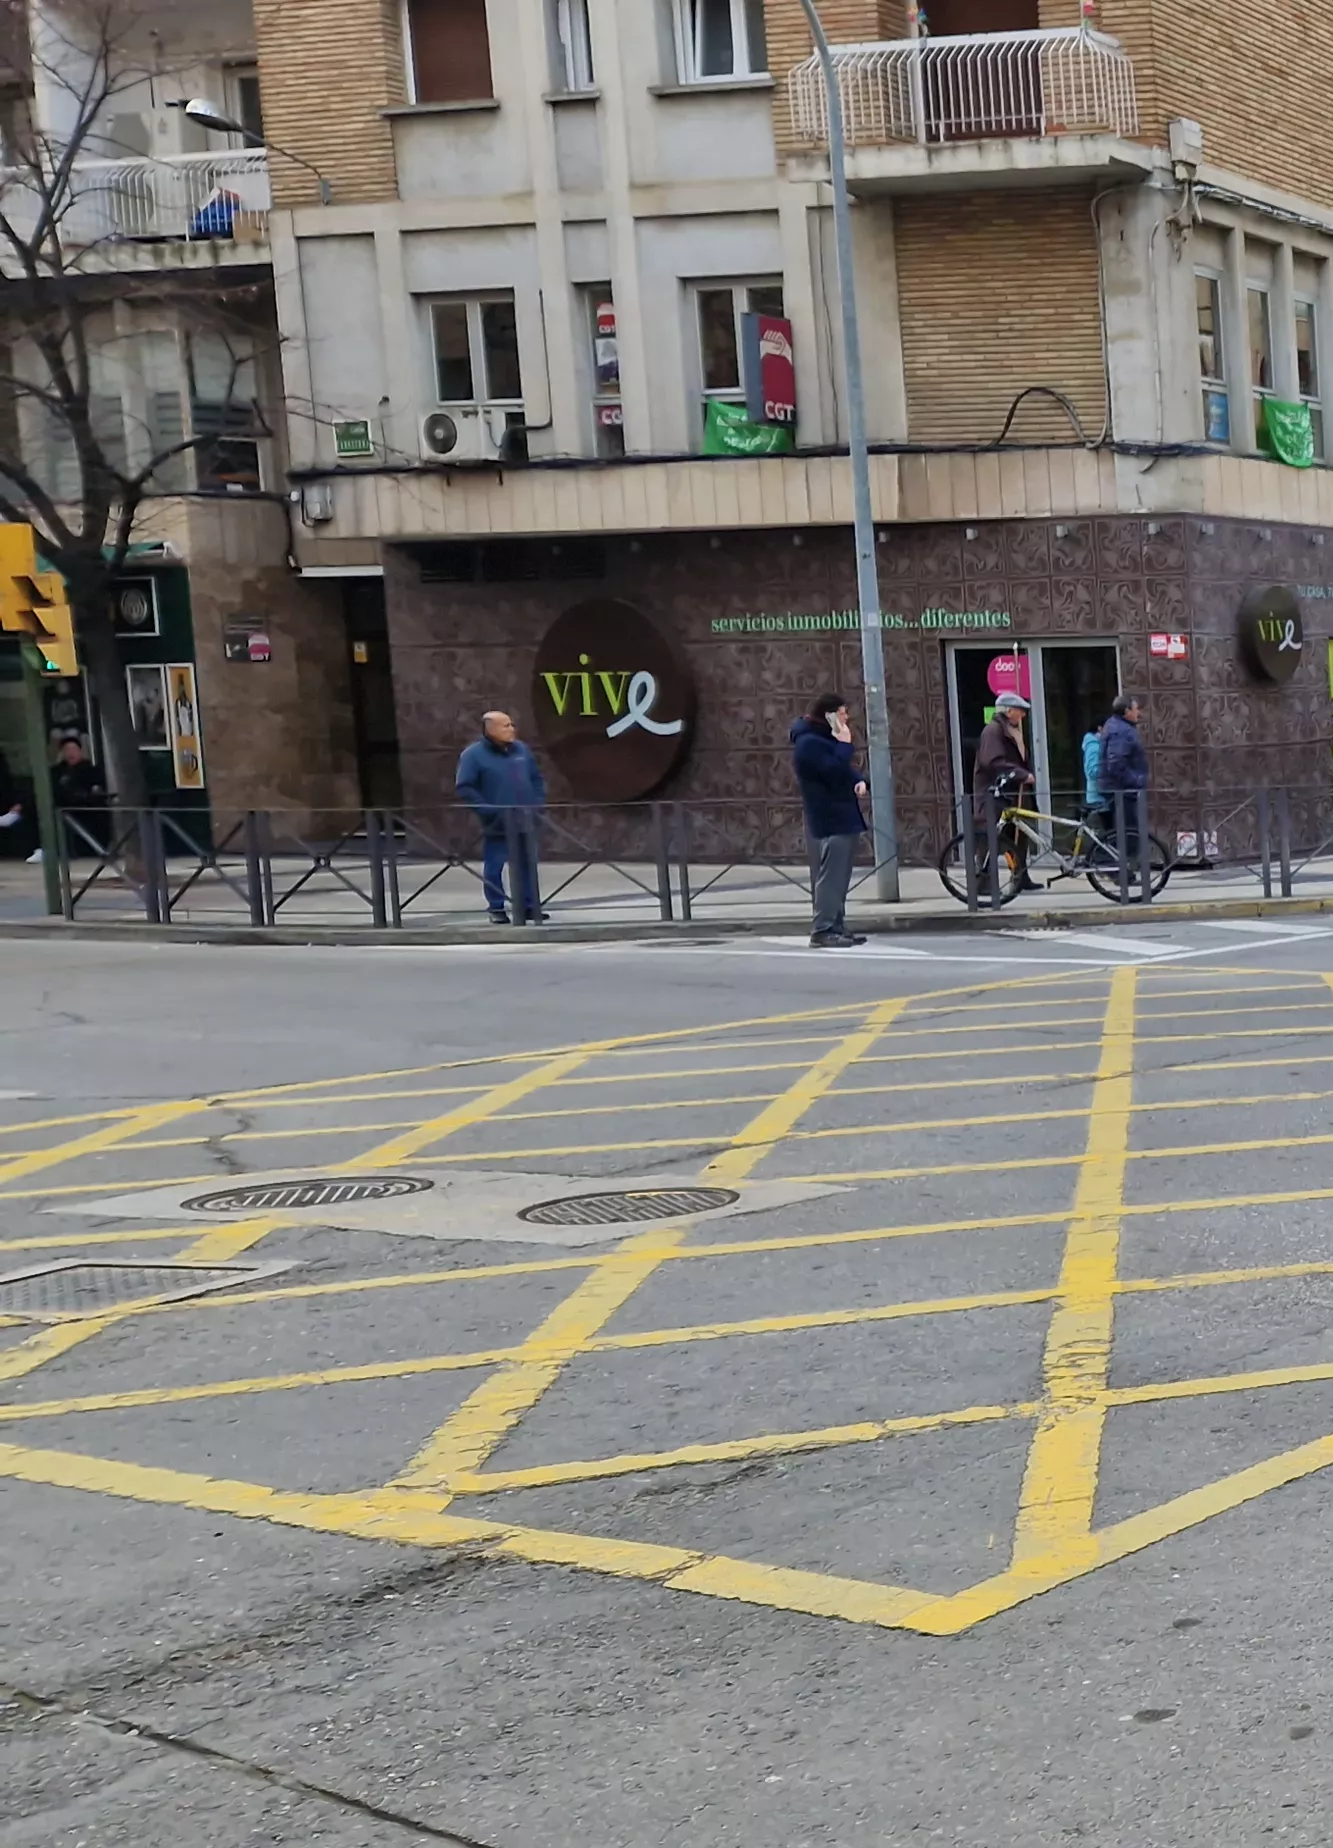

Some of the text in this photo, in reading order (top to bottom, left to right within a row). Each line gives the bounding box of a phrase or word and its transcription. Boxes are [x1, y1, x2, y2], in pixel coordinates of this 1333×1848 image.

[602, 408, 622, 424] CG
[765, 401, 794, 421] CGT
[711, 608, 1011, 632] servicios inmobiliios... diferentes
[540, 653, 684, 738] vive
